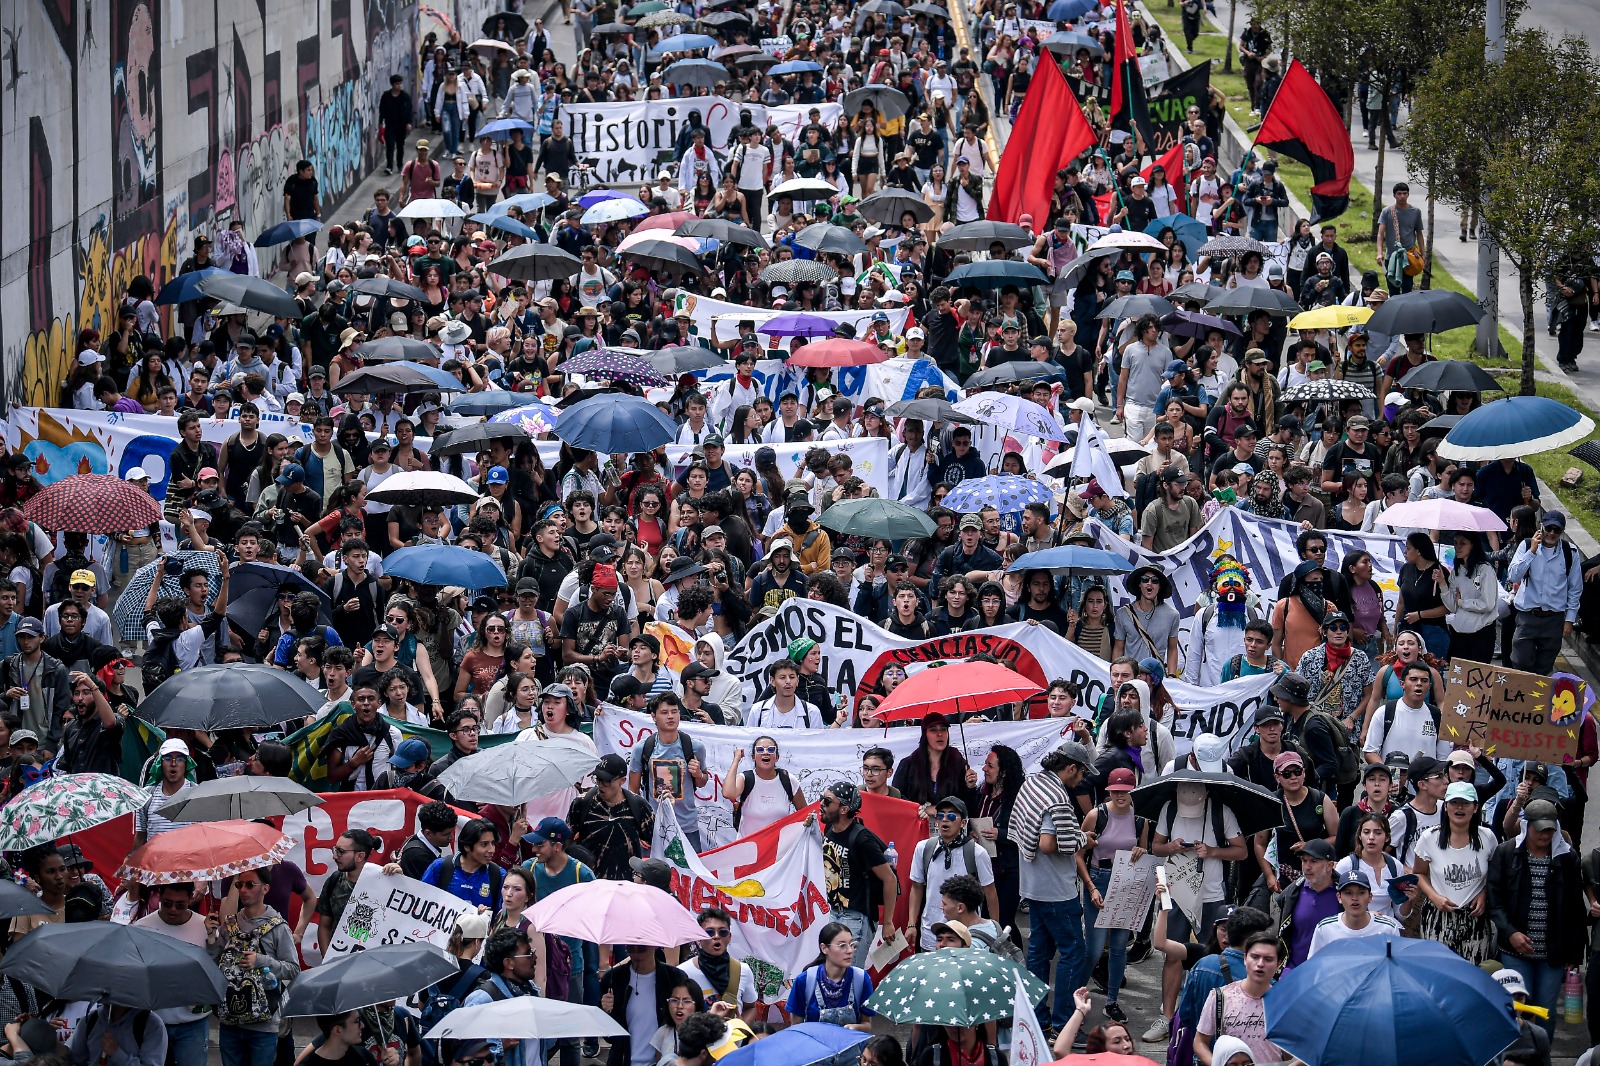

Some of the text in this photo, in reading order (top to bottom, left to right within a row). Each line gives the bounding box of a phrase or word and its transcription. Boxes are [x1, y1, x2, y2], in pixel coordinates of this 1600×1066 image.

[568, 107, 690, 153] Histori
[726, 605, 872, 675] SOMOS EL
[1504, 688, 1525, 702] LA
[1490, 708, 1544, 725] NACHO
[1491, 727, 1568, 749] RESISTE
[1348, 871, 1358, 880] LA
[386, 888, 465, 934] EDUCACI
